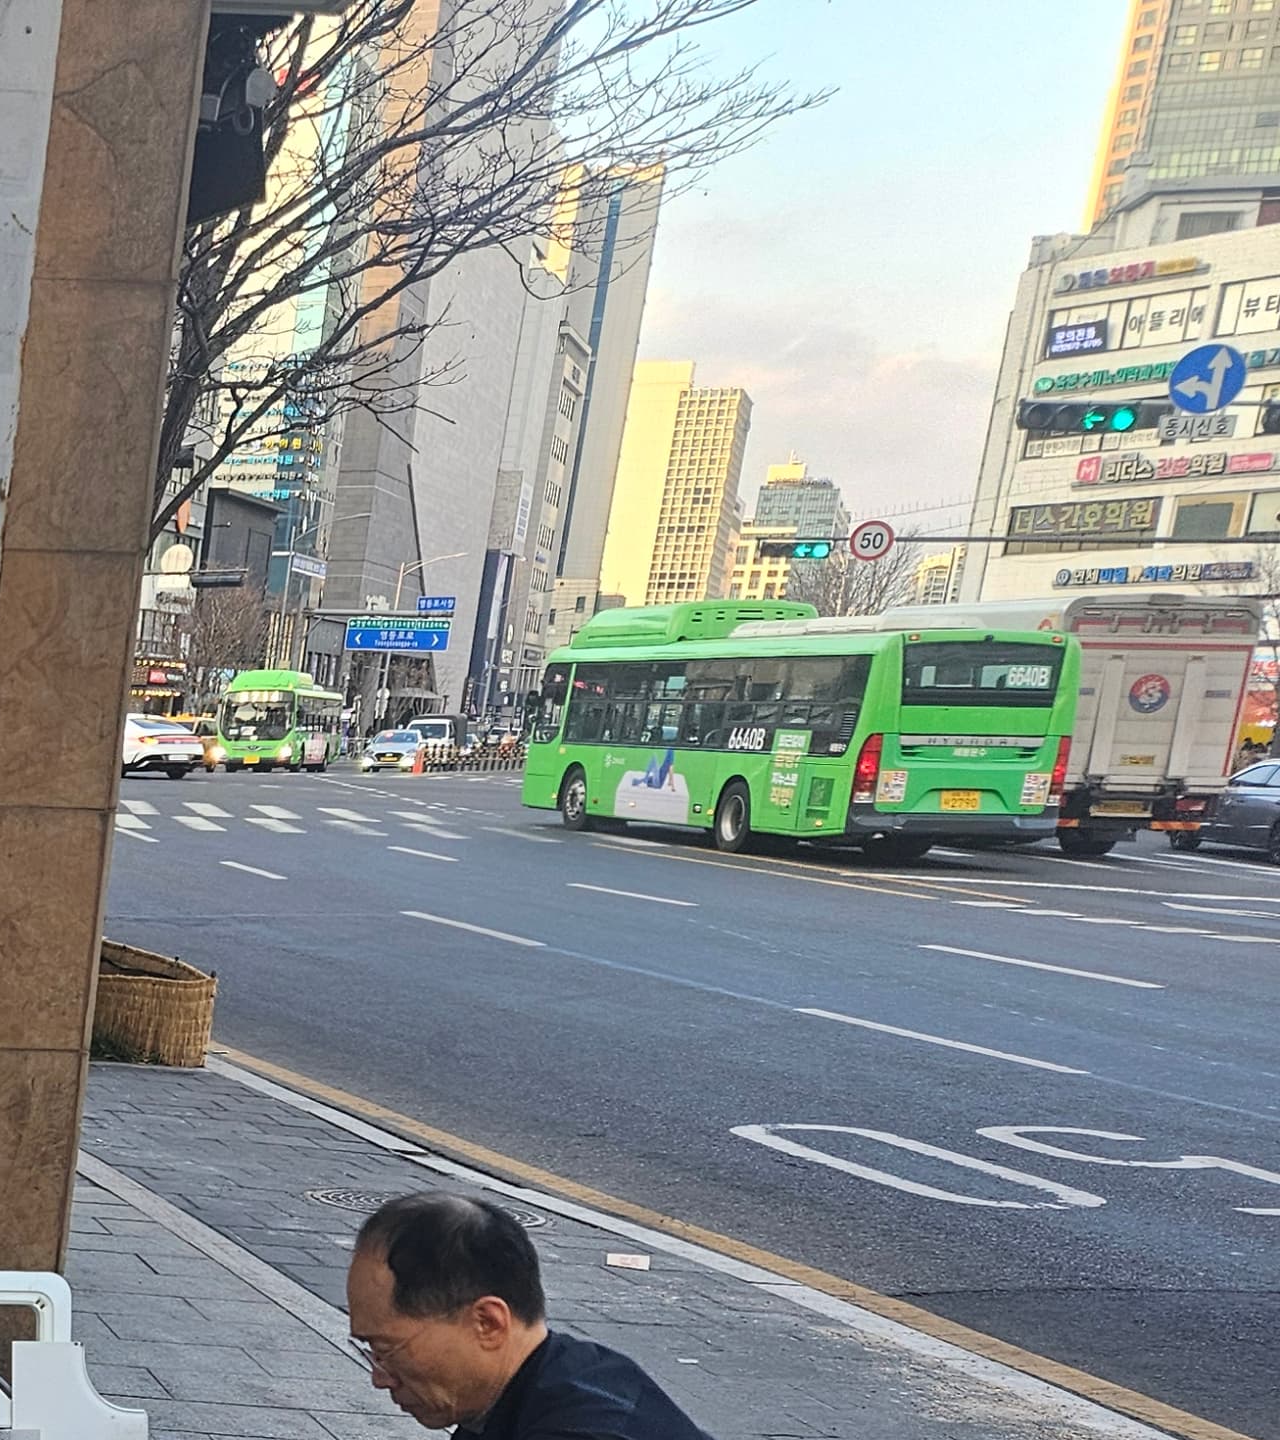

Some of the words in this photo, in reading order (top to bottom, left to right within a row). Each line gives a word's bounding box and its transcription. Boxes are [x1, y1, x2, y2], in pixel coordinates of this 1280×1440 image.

[1164, 416, 1231, 437] 동시신호
[860, 531, 885, 550] 50
[1008, 666, 1049, 686] 6640B
[728, 727, 766, 750] 6640B
